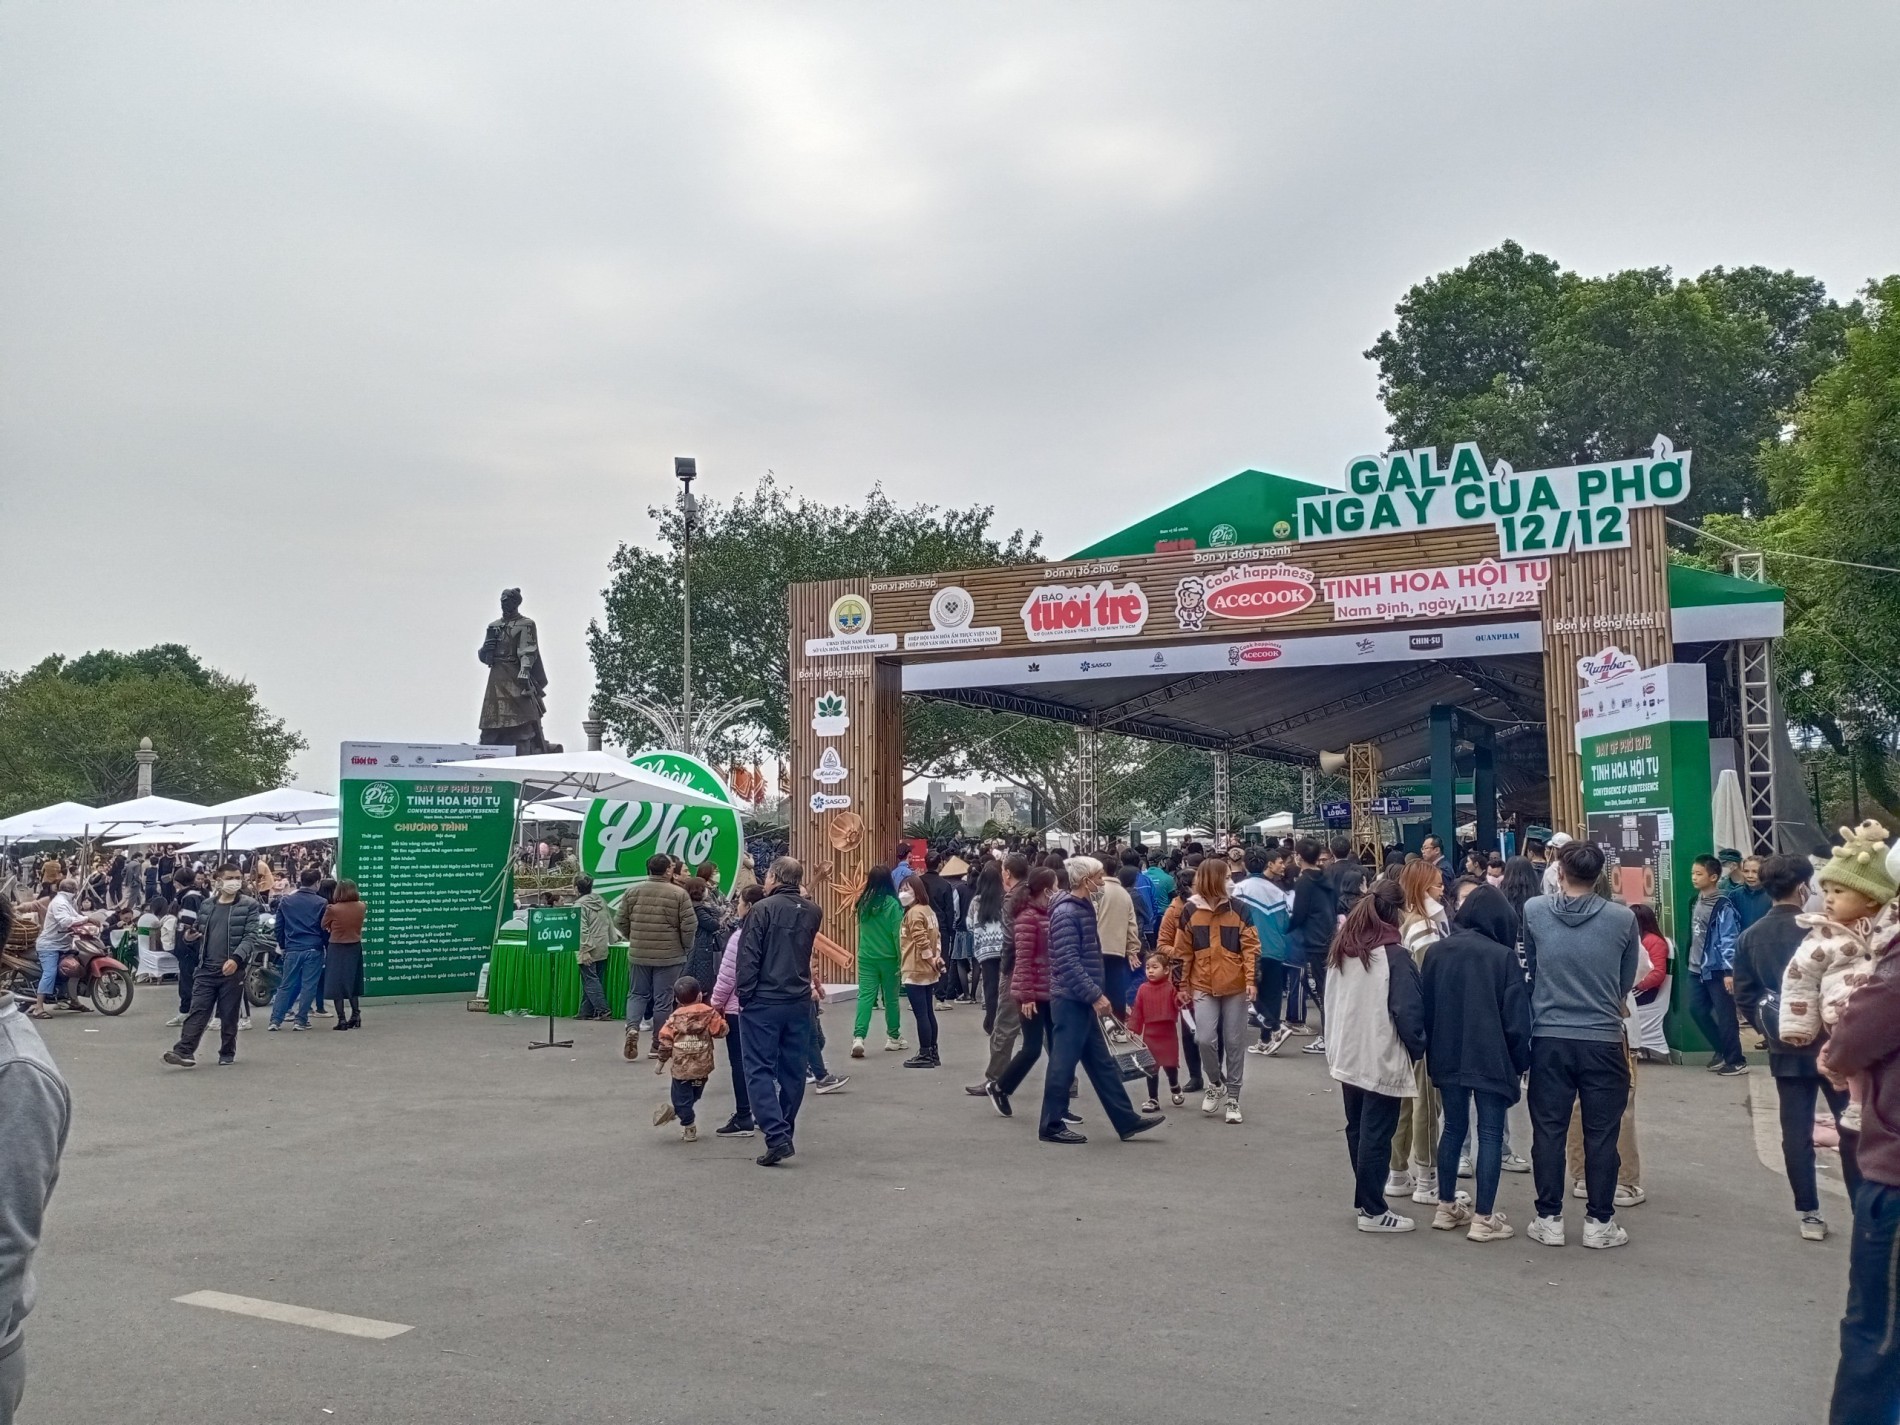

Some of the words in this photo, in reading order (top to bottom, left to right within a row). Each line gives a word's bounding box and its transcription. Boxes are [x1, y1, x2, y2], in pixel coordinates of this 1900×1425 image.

[1351, 449, 1484, 494] GALA
[1303, 482, 1436, 536] NGÀY
[1502, 506, 1623, 552] 12/12
[1194, 552, 1216, 562] Đơn
[1218, 551, 1228, 561] vị
[1231, 548, 1260, 560] đồng
[1262, 546, 1291, 556] hành
[1045, 569, 1065, 578] Đơn
[1068, 568, 1077, 578] vị
[1079, 563, 1090, 574] tổ
[1093, 564, 1118, 574] chức
[1206, 570, 1239, 589] Cook
[1244, 566, 1313, 582] happiness
[871, 583, 888, 591] Đơn
[890, 583, 898, 591] vị
[899, 578, 918, 590] phối
[920, 580, 936, 589] hợp
[1324, 576, 1381, 600] TINH
[1390, 570, 1450, 594] HOA
[1458, 561, 1507, 591] HỘI
[1516, 561, 1548, 587] TỤ
[1042, 592, 1063, 601] BÁO
[1338, 604, 1372, 618] Nam
[1376, 602, 1414, 617] Định,
[1418, 596, 1456, 614] ngày
[1461, 590, 1534, 608] 11/12/22
[1027, 593, 1091, 632] tuổi
[1094, 589, 1142, 626] trẻ
[1556, 618, 1577, 630] Đơn
[1581, 618, 1592, 629] vị
[1594, 612, 1622, 629] đồng
[1626, 612, 1654, 626] hành
[1411, 635, 1440, 646] CHIN-SU
[1475, 632, 1520, 642] QUANPHAM
[1582, 656, 1632, 676] Number
[1598, 652, 1614, 680] 1
[1591, 764, 1610, 782] TINH
[1611, 760, 1628, 779] HOA
[1630, 756, 1644, 780] HỘI
[1646, 756, 1659, 778] TỤ
[415, 784, 435, 793] DAY
[437, 785, 449, 793] OF
[472, 785, 493, 794] 12/12
[406, 796, 434, 805] TINH
[437, 796, 460, 805] HOA
[463, 795, 482, 807] HỘI
[485, 796, 500, 807] TỤ
[1327, 808, 1335, 816] LÒ
[394, 822, 438, 832] CHƯƠNG
[441, 821, 468, 832] TRÌNH
[595, 800, 718, 872] Phở
[538, 927, 551, 940] LỐI
[554, 928, 572, 939] VÀO
